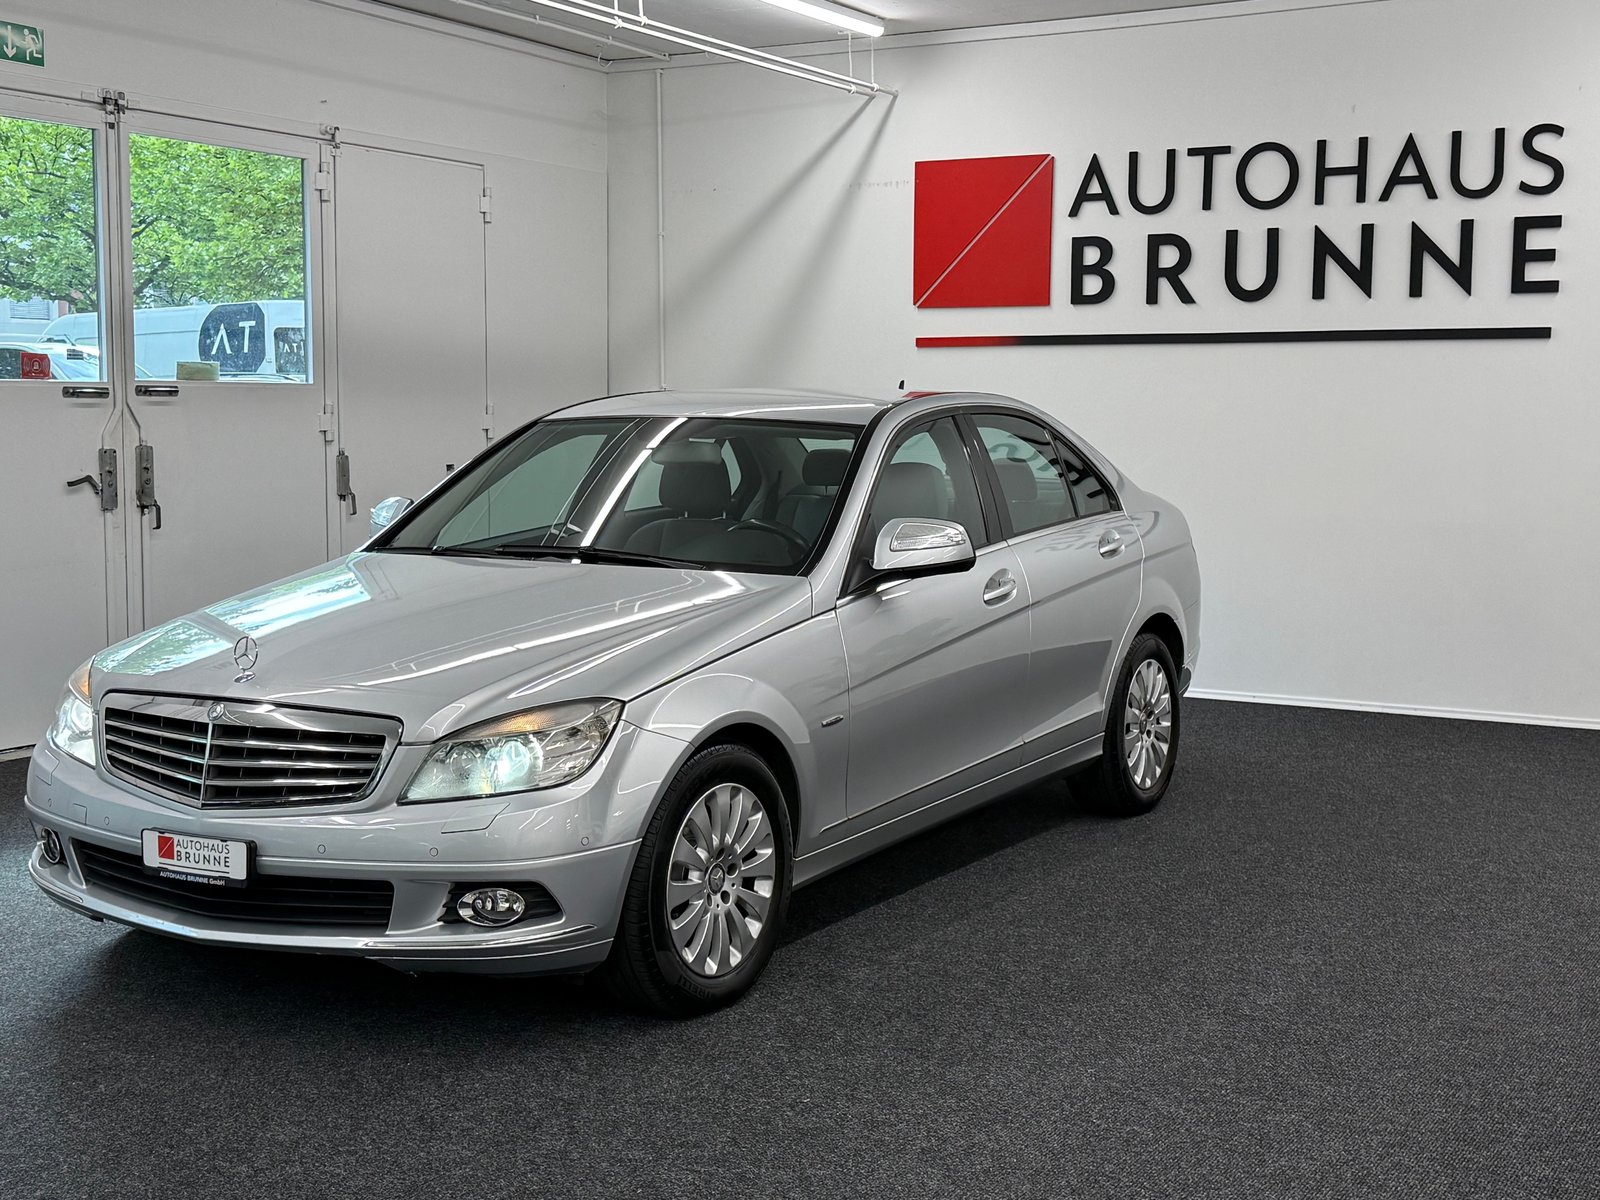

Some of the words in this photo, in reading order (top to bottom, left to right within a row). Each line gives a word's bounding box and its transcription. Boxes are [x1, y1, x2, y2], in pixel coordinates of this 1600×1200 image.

[1067, 123, 1566, 217] AUTOHAUS
[1071, 215, 1563, 305] BRUNNE
[176, 838, 230, 855] AUTOHAUS
[176, 850, 230, 868] BRUNNE
[160, 871, 187, 881] AUTOHAUS
[187, 875, 208, 884] BRUNNE
[209, 878, 225, 886] GmbH
